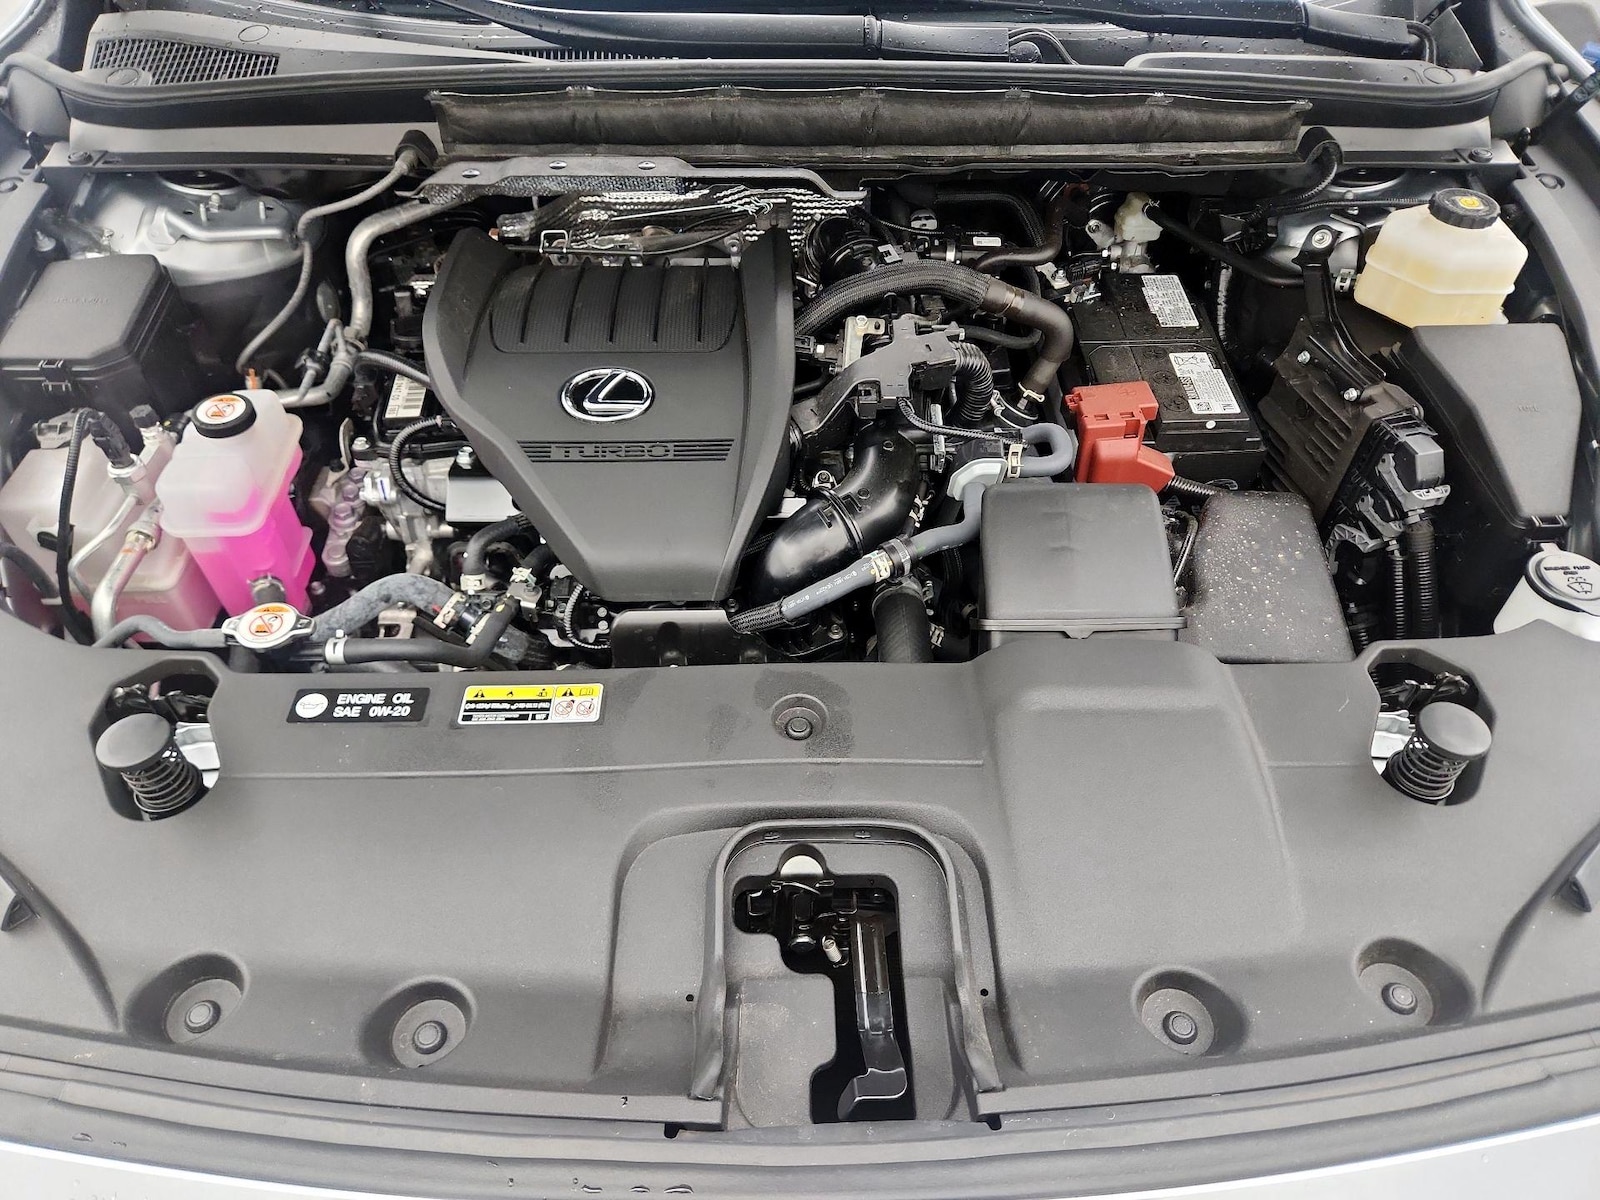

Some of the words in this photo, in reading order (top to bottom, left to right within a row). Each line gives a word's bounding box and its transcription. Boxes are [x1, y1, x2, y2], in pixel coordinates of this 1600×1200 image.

[552, 443, 674, 459] TURBO
[336, 693, 387, 705] ENGINE
[392, 692, 415, 705] OIL
[332, 706, 362, 718] SAE
[368, 705, 411, 718] 0W-20
